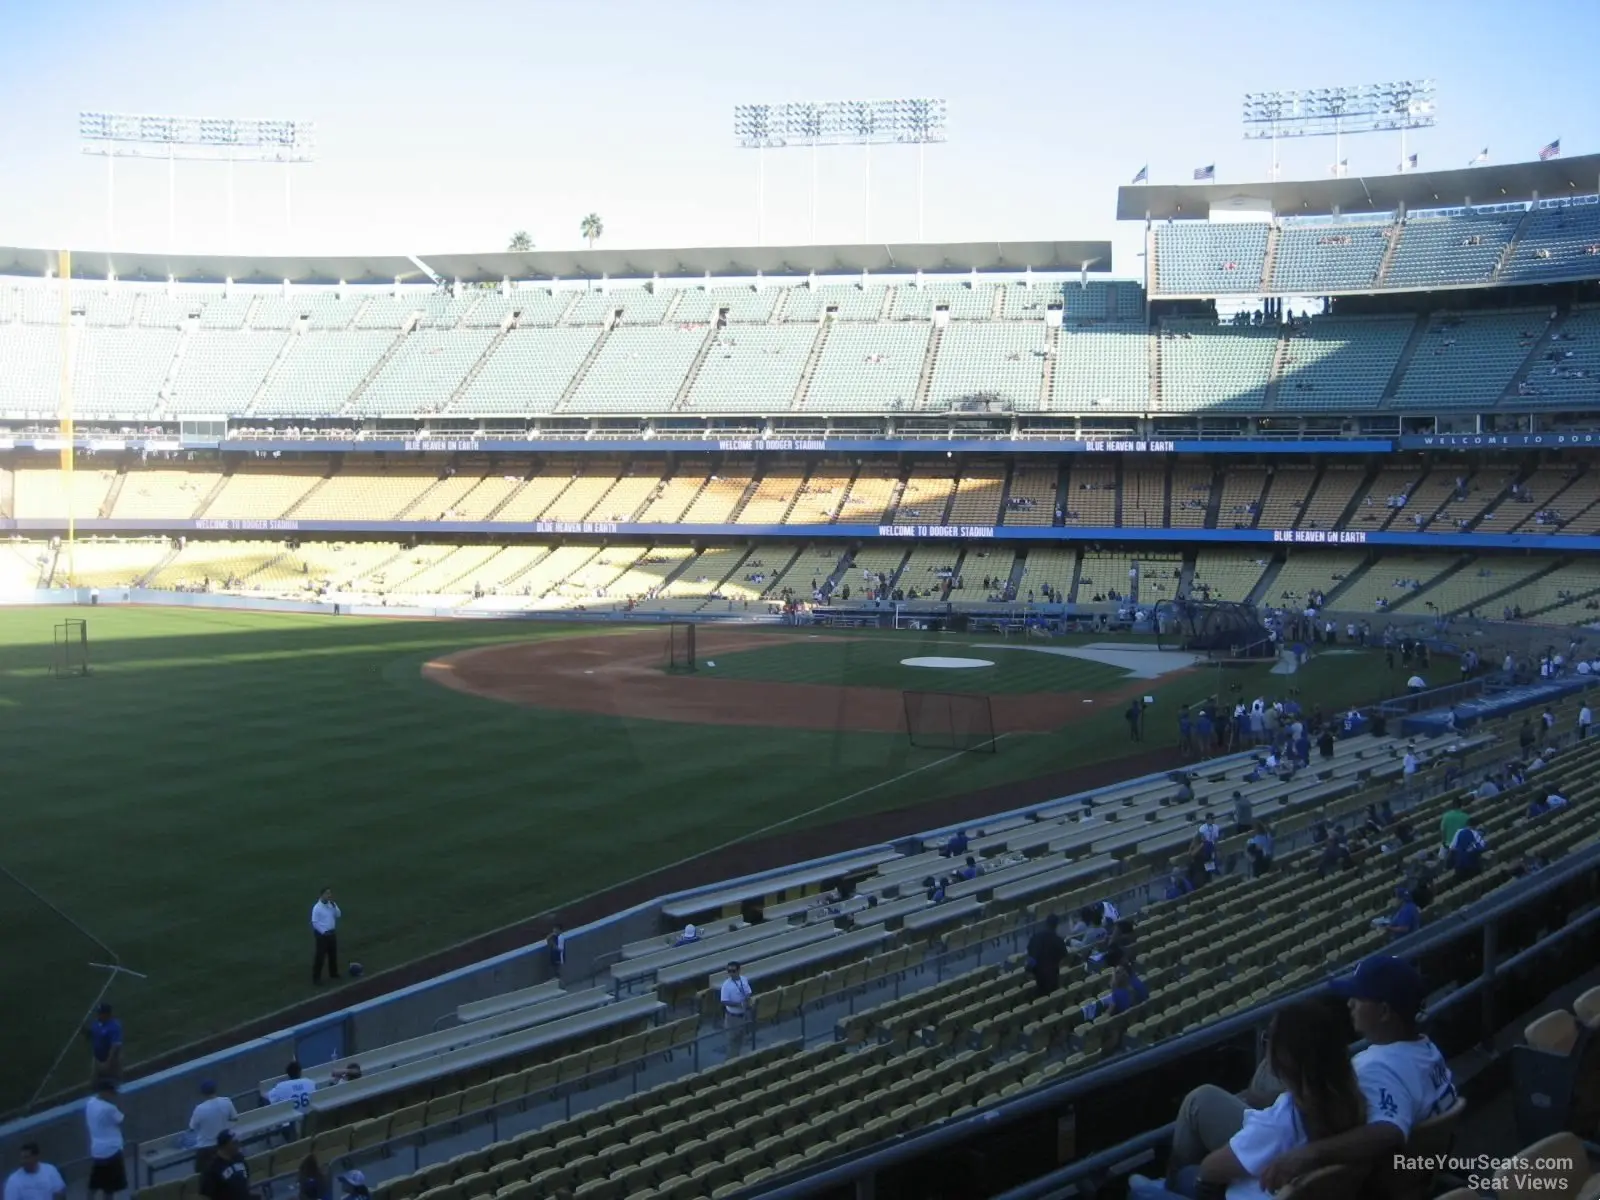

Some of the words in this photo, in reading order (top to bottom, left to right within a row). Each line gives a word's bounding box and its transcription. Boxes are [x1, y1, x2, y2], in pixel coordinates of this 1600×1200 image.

[720, 440, 753, 450] WELCOME
[755, 440, 764, 450] TO
[766, 440, 793, 450] DODGER
[794, 440, 826, 450] STADIUM
[1424, 436, 1508, 445] WELCOME
[1523, 436, 1542, 444] TO
[1558, 435, 1600, 443] DOD
[1086, 441, 1104, 452] BLUE
[1106, 441, 1134, 452] HEAVEN
[1136, 441, 1147, 452] ON
[1150, 441, 1174, 452] EARTH
[555, 522, 581, 533] HEAVEN
[879, 525, 915, 537] WELCOME
[918, 526, 927, 537] TO
[929, 526, 959, 537] DODGER
[960, 526, 994, 537] STADIUM
[1274, 530, 1293, 541] BLUE
[1295, 531, 1325, 542] HEAVEN
[1327, 531, 1338, 542] ON
[1340, 532, 1365, 543] EARTH
[1379, 1087, 1398, 1114] LA
